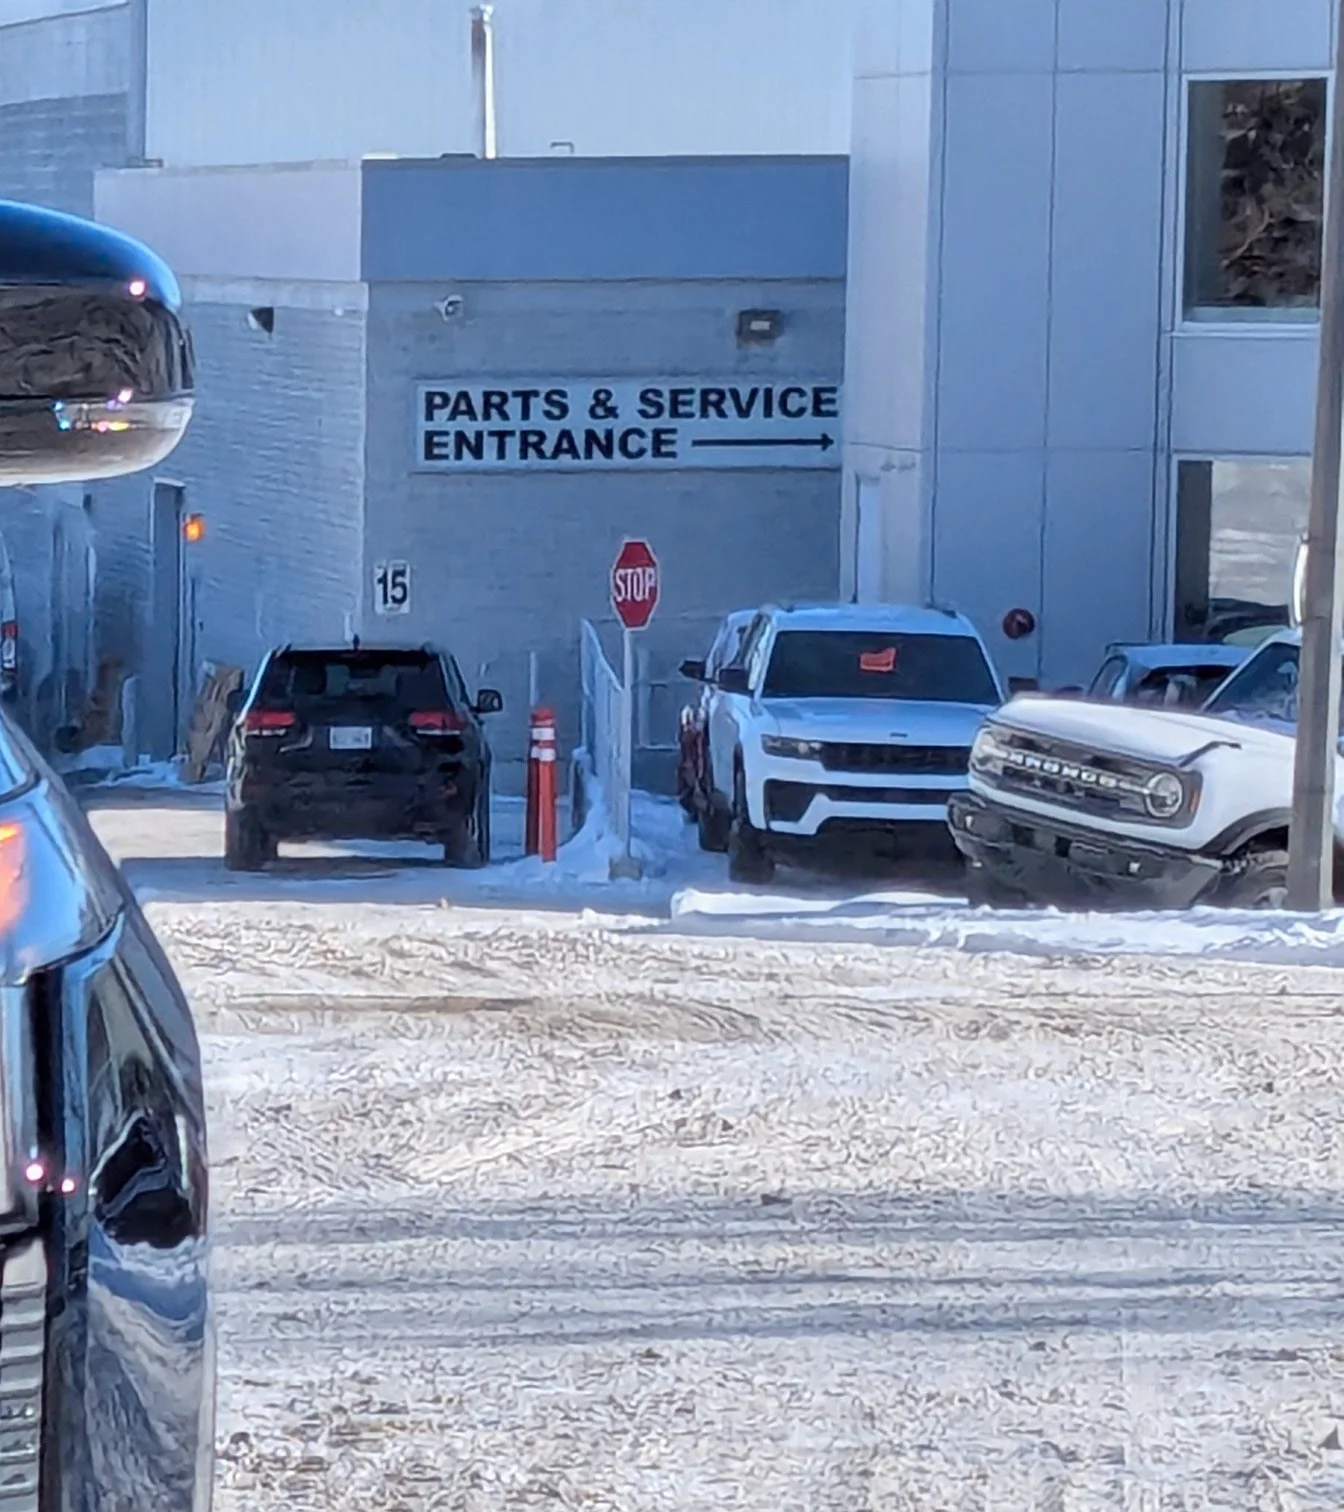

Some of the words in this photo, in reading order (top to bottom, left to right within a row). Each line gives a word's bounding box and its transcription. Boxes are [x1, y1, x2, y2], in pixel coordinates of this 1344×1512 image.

[424, 389, 570, 422] PARTS
[588, 388, 620, 420] &
[637, 386, 840, 420] SERVICE
[423, 427, 678, 461] ENTRANCE
[376, 567, 409, 605] 15
[614, 566, 656, 603] STOP
